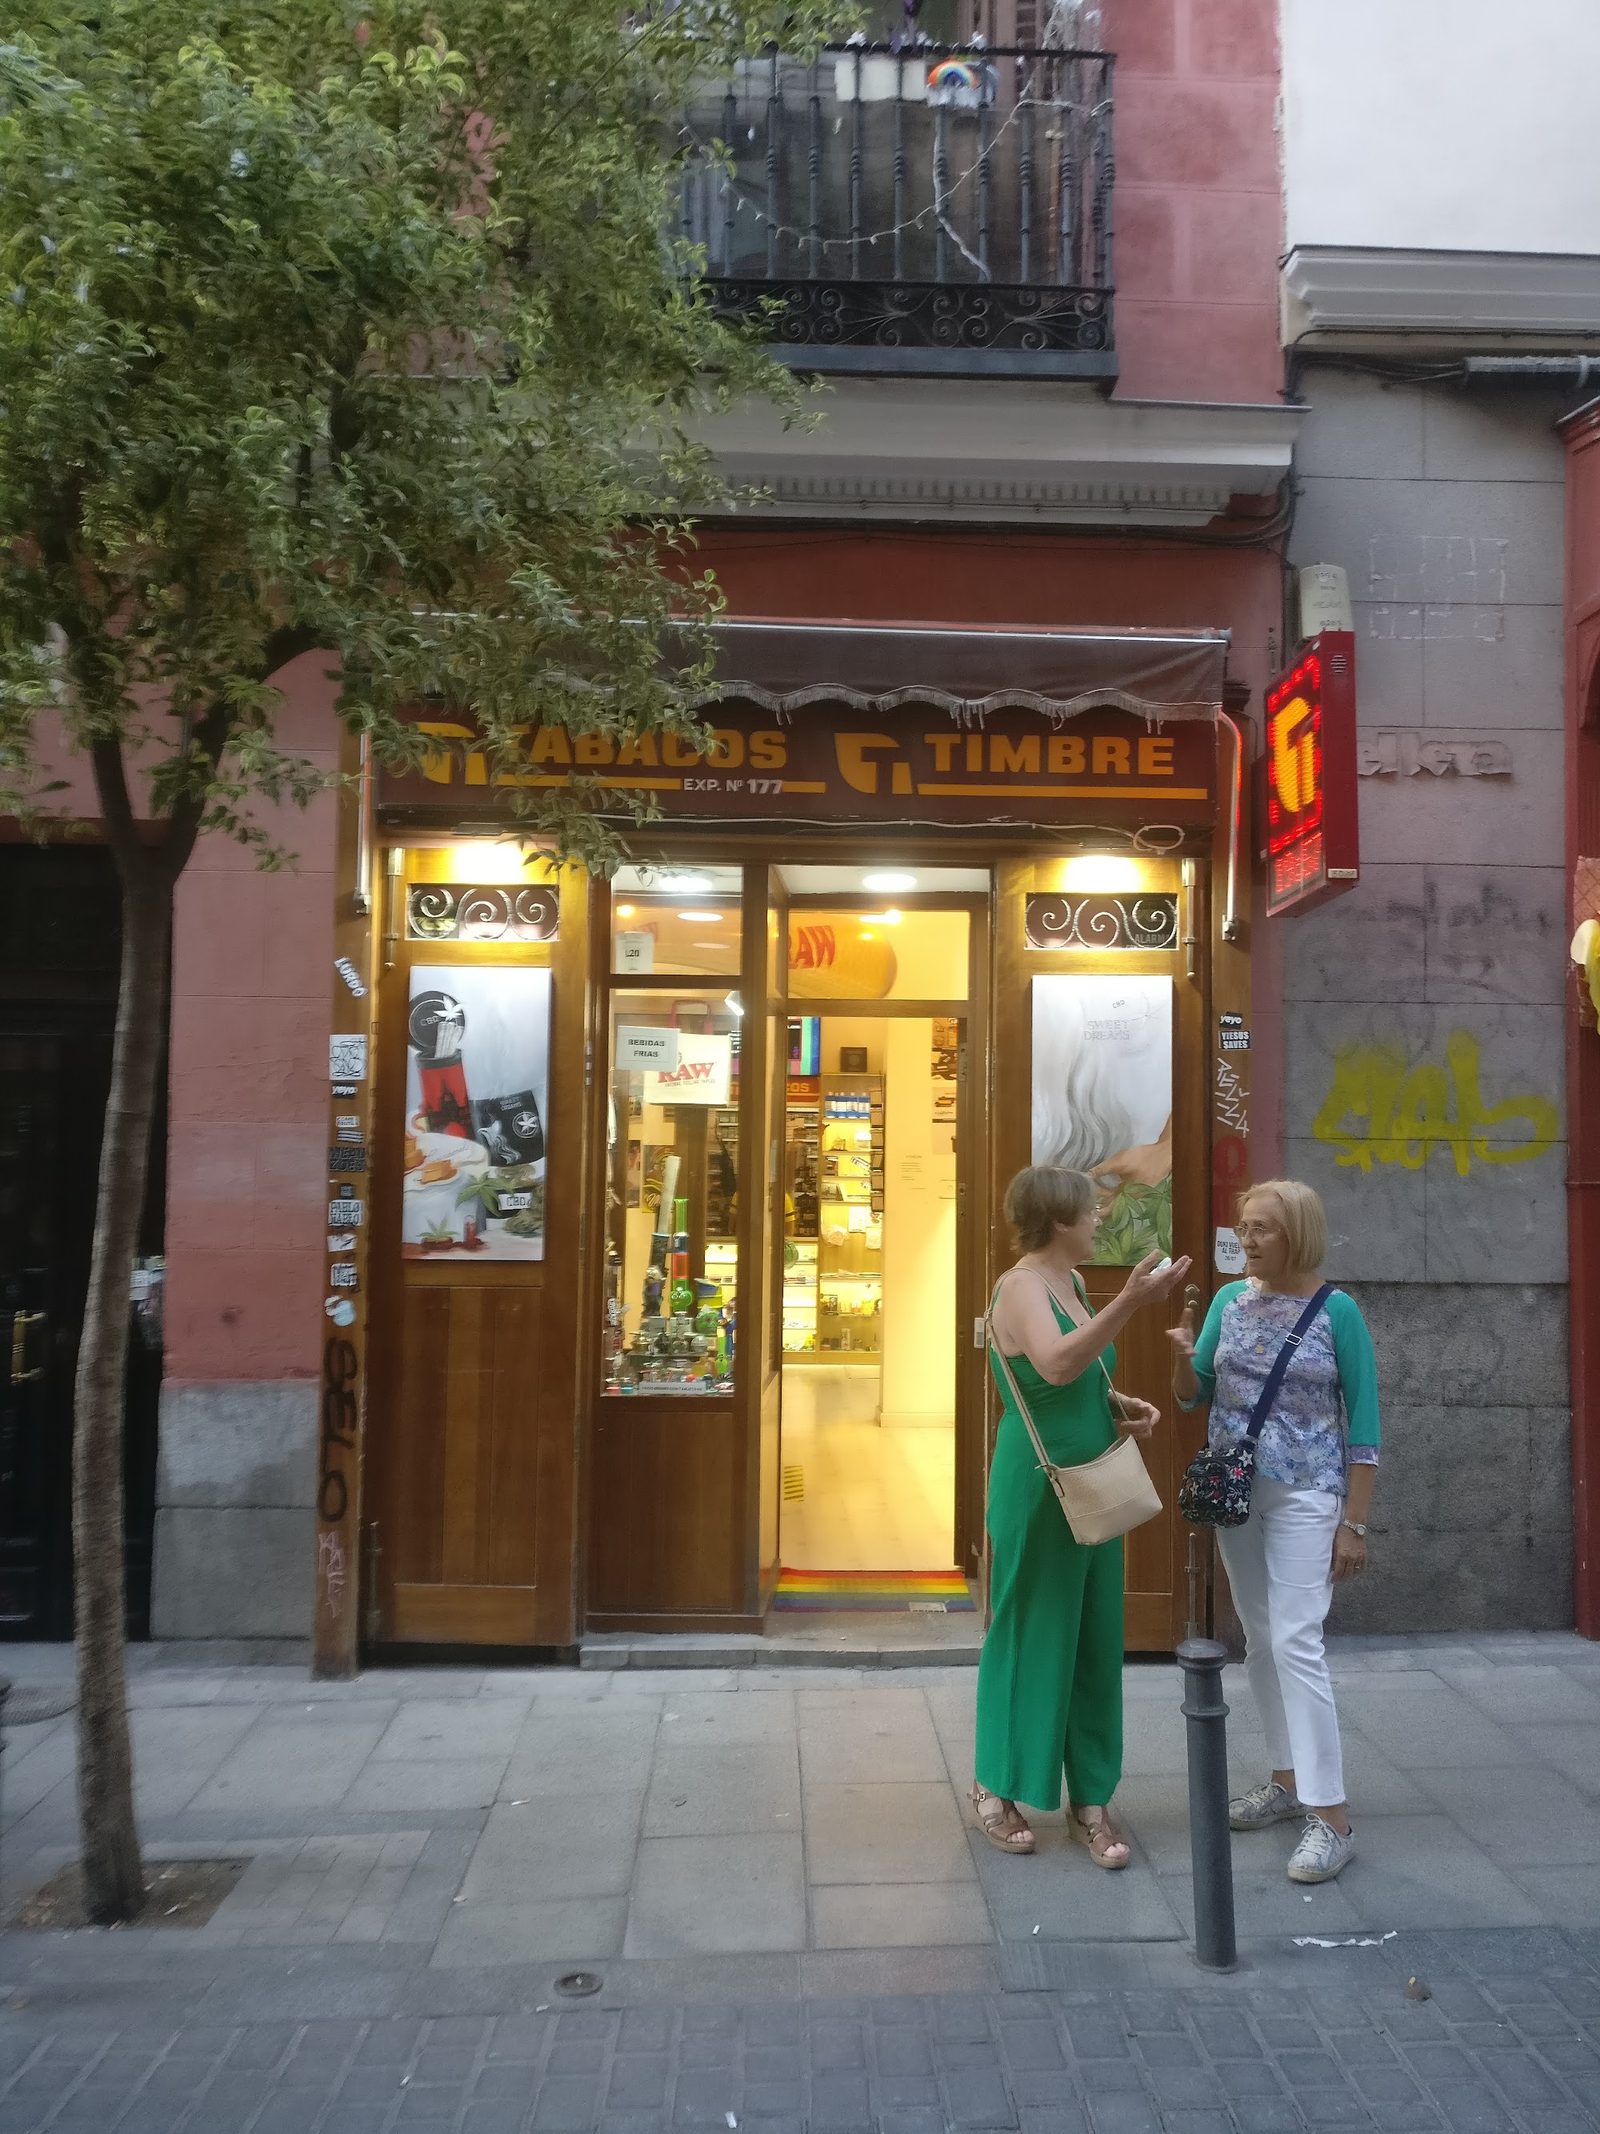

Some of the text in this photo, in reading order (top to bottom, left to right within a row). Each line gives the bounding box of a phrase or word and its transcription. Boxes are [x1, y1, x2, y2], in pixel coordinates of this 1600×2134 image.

[924, 733, 1175, 775] TIMBRE
[683, 778, 722, 792] EXP.
[746, 778, 784, 795] 177
[1087, 1019, 1129, 1030] SWEET
[1219, 1015, 1243, 1025] yeyo
[1084, 1030, 1131, 1041] DREAMS
[628, 1039, 665, 1047] BEBIDAS
[1223, 1040, 1249, 1049] SAVES
[633, 1050, 659, 1058] FRIAS
[658, 1062, 715, 1084] RAW
